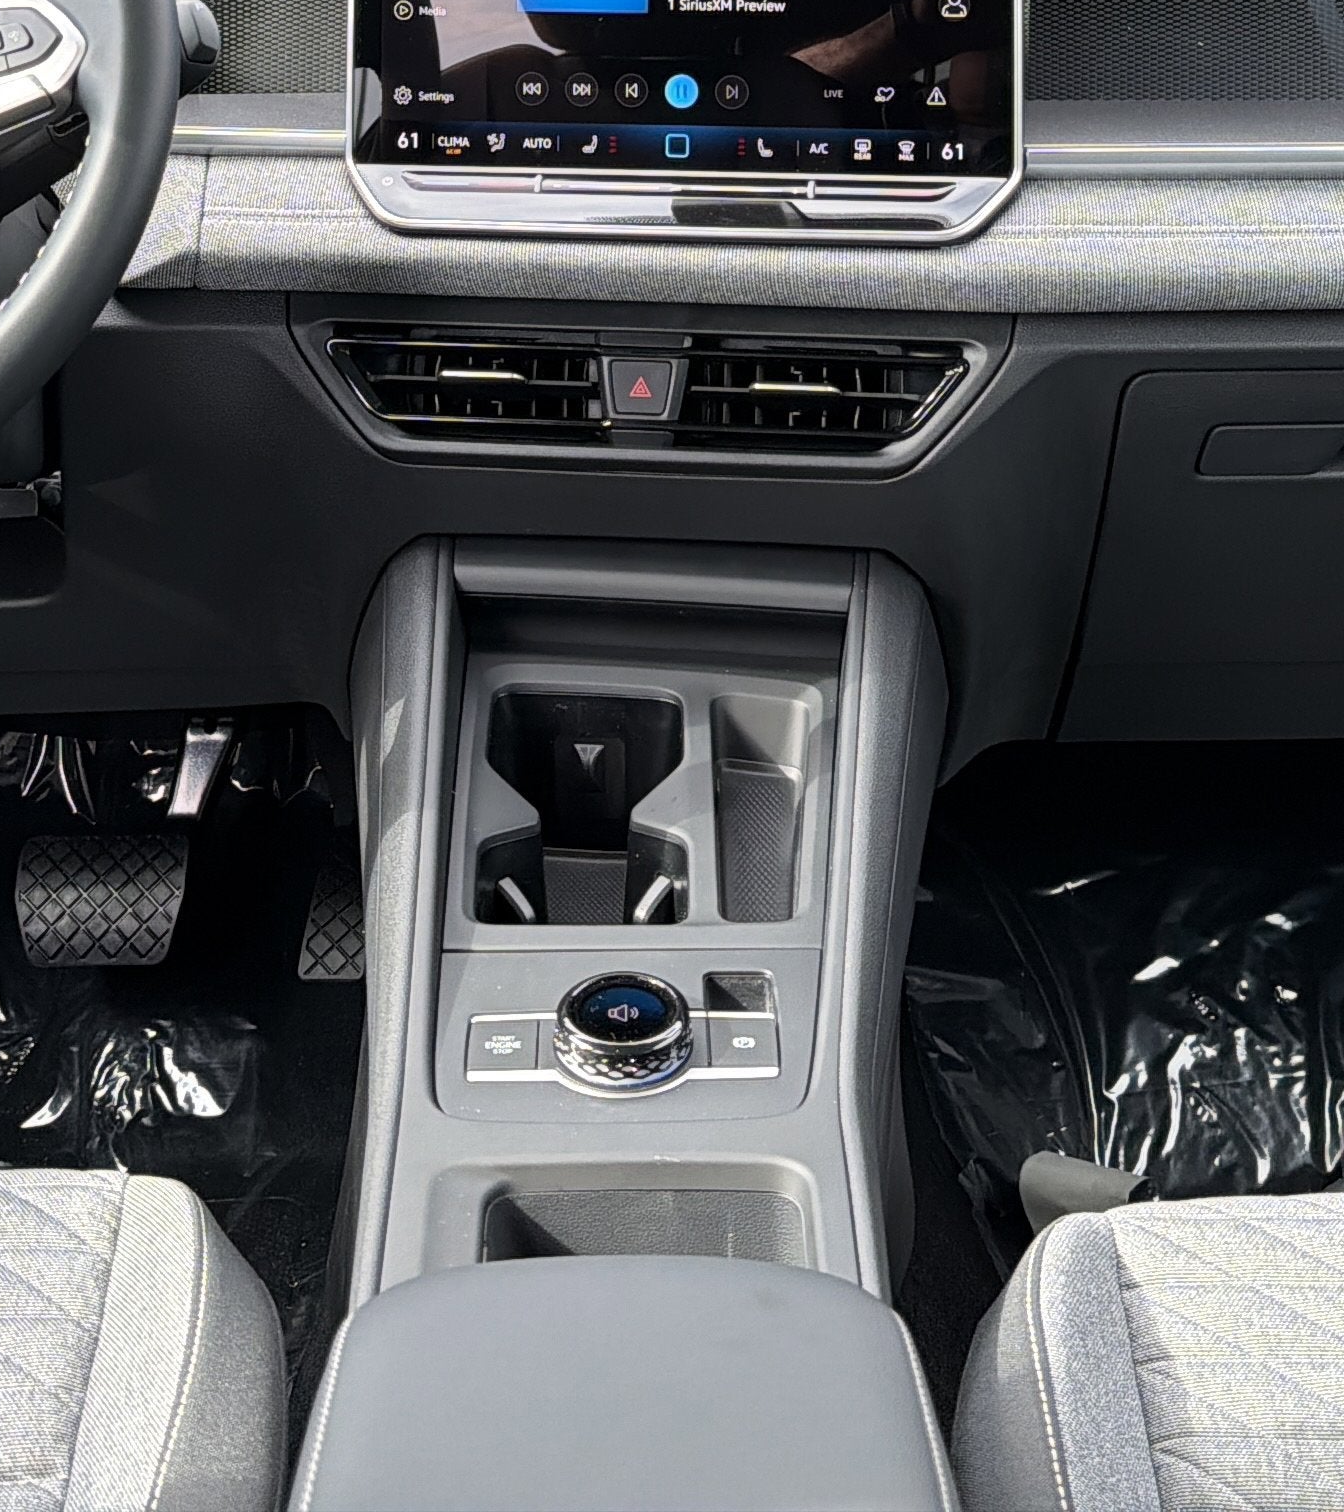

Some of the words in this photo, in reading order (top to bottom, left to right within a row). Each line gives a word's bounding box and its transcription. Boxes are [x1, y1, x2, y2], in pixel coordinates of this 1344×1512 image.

[418, 5, 447, 18] Media
[667, 0, 675, 11] 1
[679, 0, 733, 12] SiriusXM
[736, 0, 786, 13] Preview
[418, 90, 455, 104] Settings
[823, 89, 844, 99] LIVE
[397, 132, 419, 149] 61
[437, 136, 471, 149] CLIMA
[522, 137, 553, 150] AUTO
[808, 142, 830, 155] A/C
[941, 142, 965, 161] 61
[491, 1034, 517, 1042] START
[484, 1039, 522, 1050] ENGINE
[492, 1048, 514, 1056] STOP
